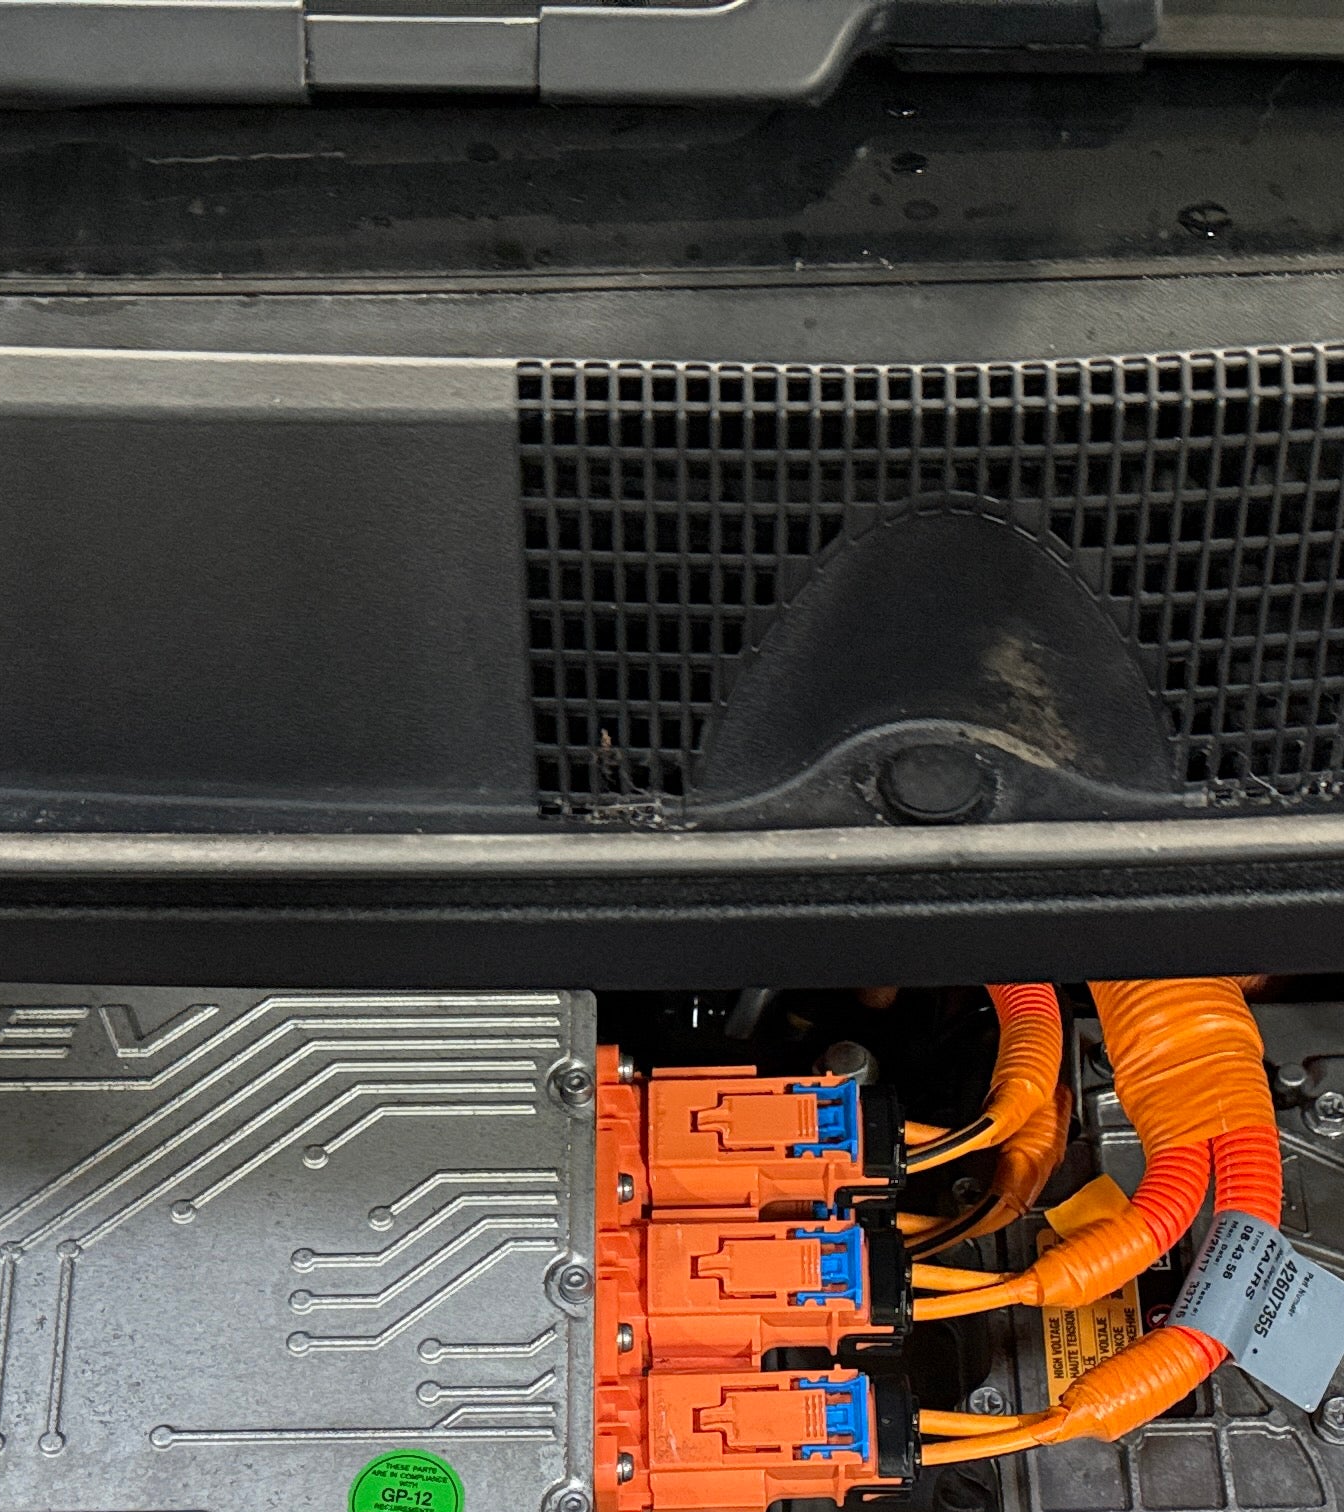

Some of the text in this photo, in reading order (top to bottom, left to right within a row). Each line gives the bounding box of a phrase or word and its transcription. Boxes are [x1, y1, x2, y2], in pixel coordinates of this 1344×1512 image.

[1223, 1224, 1255, 1281] 08:43:56
[1244, 1238, 1278, 1301] KAJRS
[1253, 1258, 1299, 1339] 42607355
[1049, 1317, 1064, 1379] HIGH VOLTAGE
[1064, 1310, 1080, 1378] HAUTE TENSION
[1096, 1317, 1109, 1354] VOLTAJE
[372, 1470, 388, 1478] ARE
[400, 1473, 448, 1484] COMPLIANCE
[386, 1462, 438, 1474] THESE PARTS
[400, 1480, 418, 1488] WITH
[381, 1488, 433, 1507] GP-12
